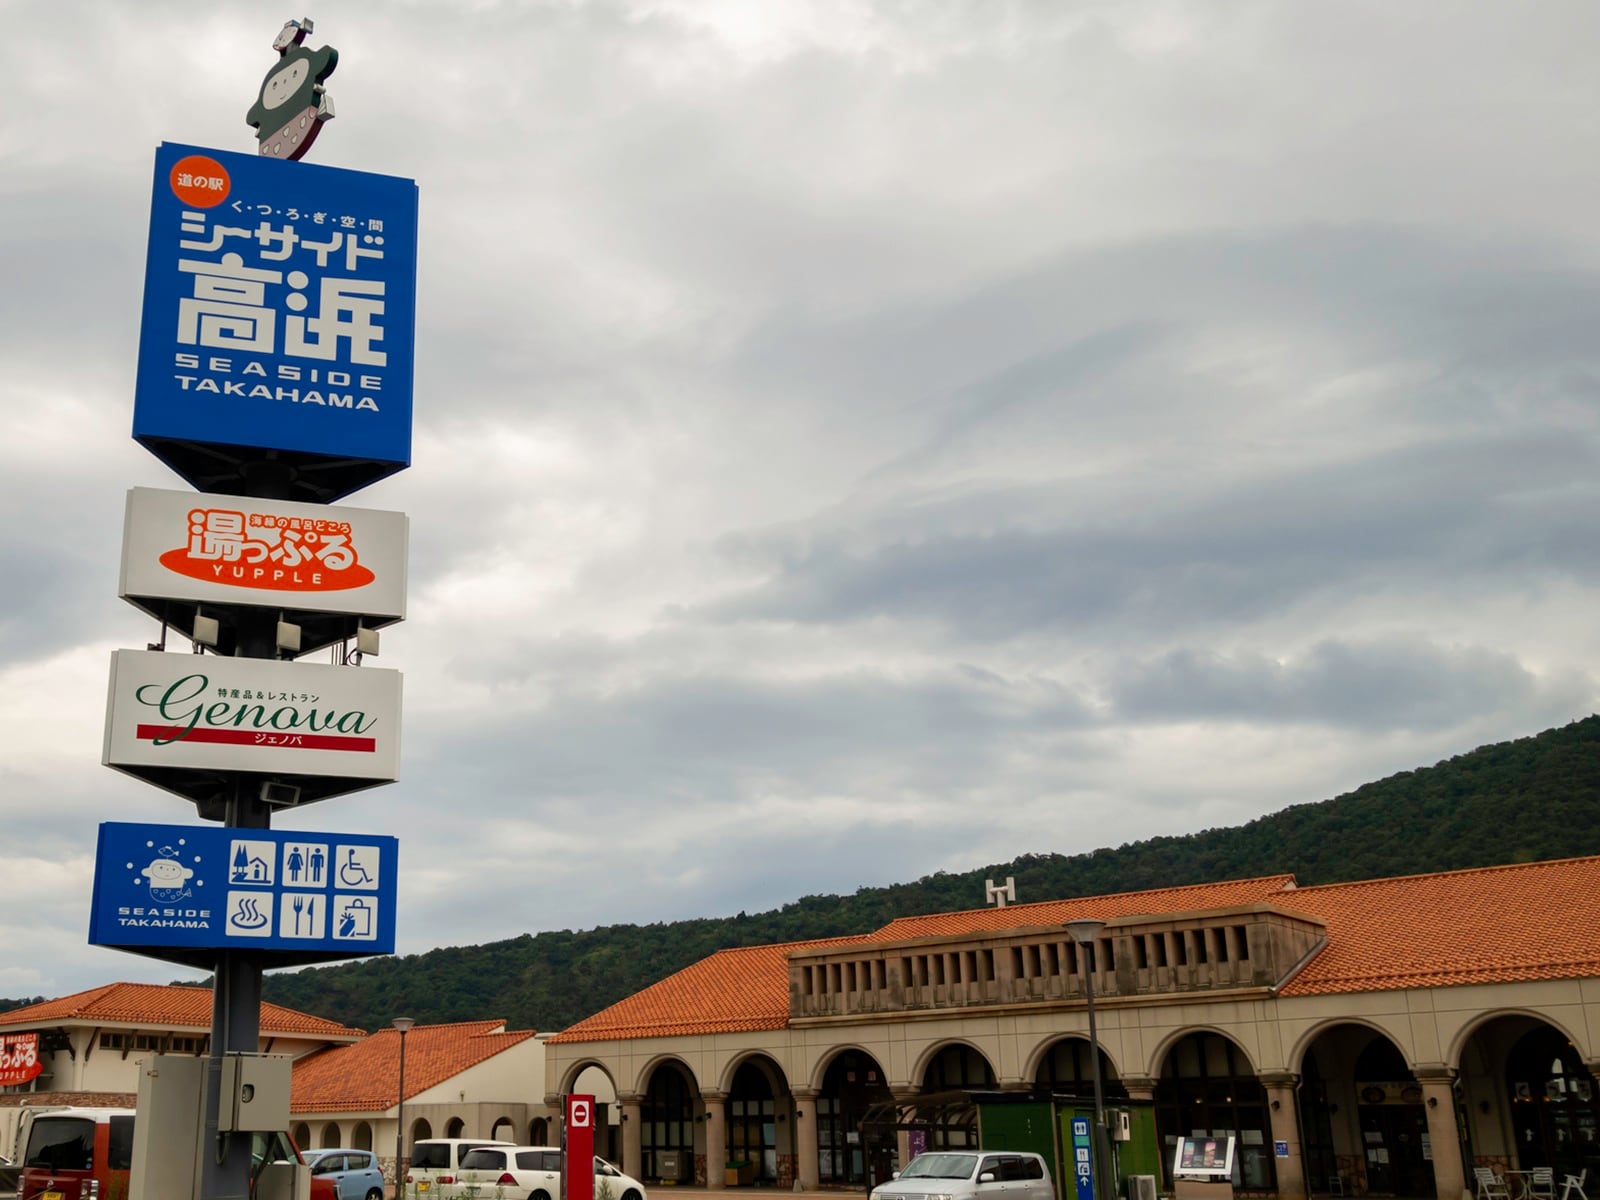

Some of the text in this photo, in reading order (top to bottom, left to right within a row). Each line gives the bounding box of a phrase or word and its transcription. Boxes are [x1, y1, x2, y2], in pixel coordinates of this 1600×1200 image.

[177, 174, 224, 191] 道の駅
[180, 211, 384, 271] シーサイド
[177, 252, 387, 367] 高浜
[175, 353, 382, 390] SEASIDE
[174, 375, 379, 412] TAKAHAMA
[212, 564, 322, 584] YUPPLE
[135, 674, 377, 745] Genova
[255, 733, 302, 745] ジェノバ
[118, 907, 211, 918] SEASIDE
[118, 919, 210, 929] TAKAHAMA
